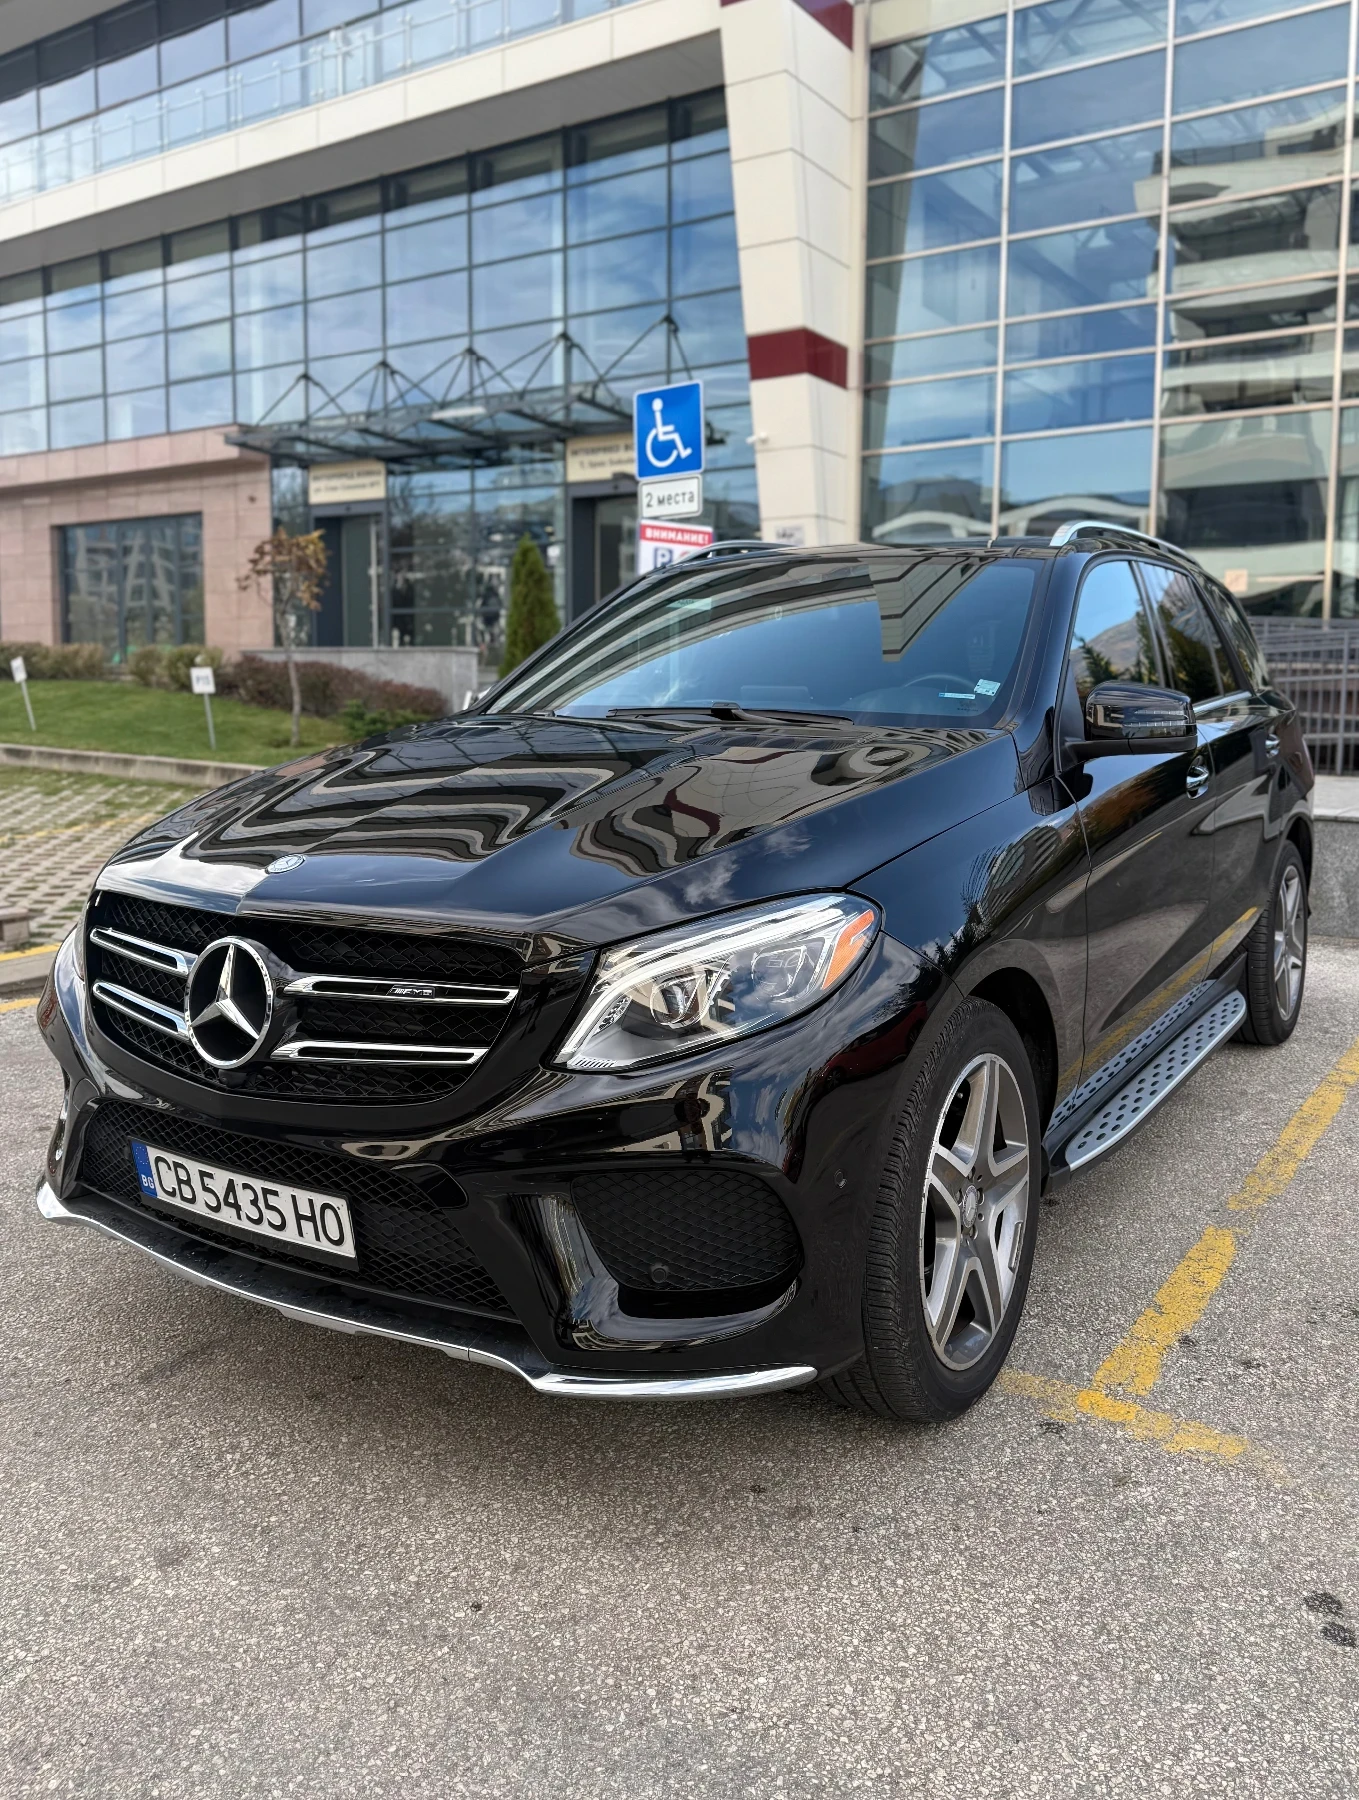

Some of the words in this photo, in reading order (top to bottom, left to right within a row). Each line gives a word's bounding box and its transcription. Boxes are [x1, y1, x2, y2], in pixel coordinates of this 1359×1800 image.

[645, 492, 653, 508] 2
[657, 491, 695, 506] места
[645, 528, 709, 545] ВНИМАНИЕ!
[141, 1174, 155, 1189] BG
[154, 1155, 197, 1205] CB
[198, 1169, 287, 1232] 5435
[291, 1193, 345, 1246] HO
